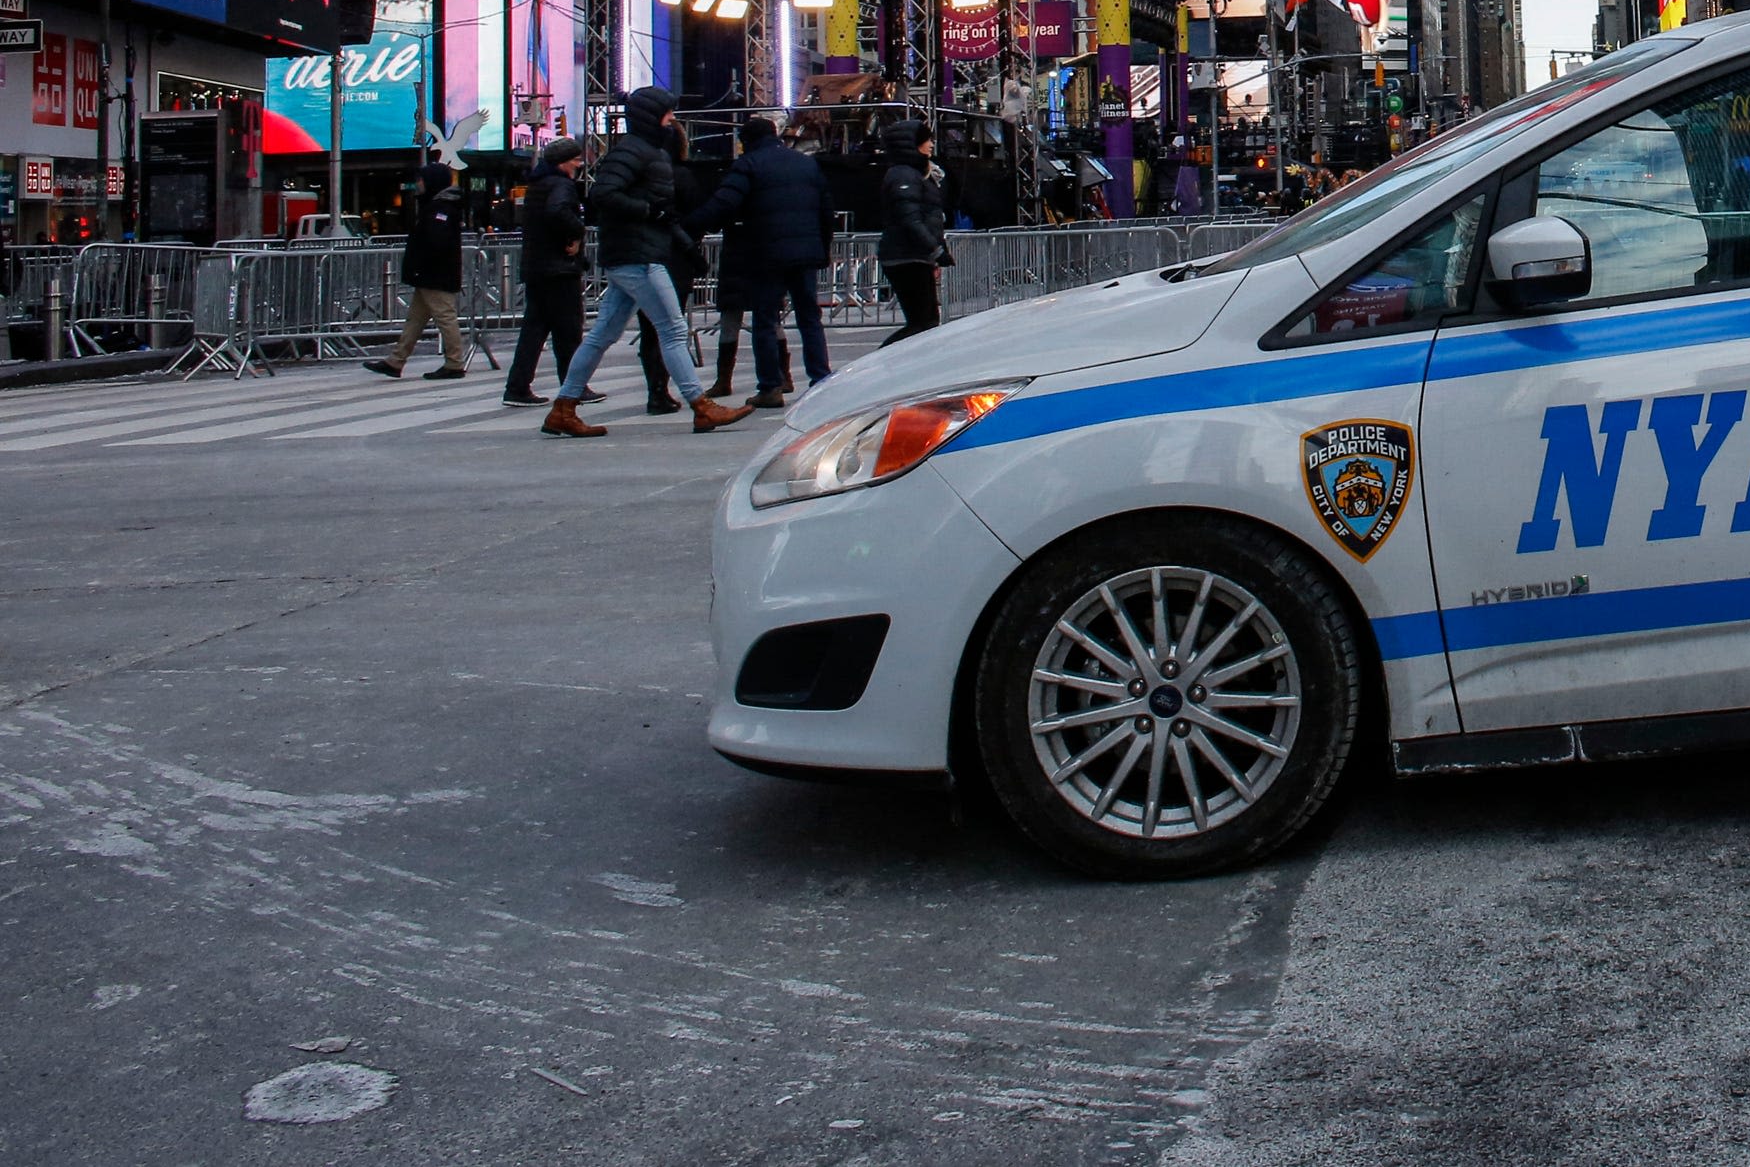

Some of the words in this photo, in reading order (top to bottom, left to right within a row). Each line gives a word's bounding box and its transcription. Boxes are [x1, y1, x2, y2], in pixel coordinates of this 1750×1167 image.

[971, 25, 987, 38] on
[76, 50, 99, 82] UNI
[1099, 102, 1125, 112] planet
[1328, 425, 1388, 445] POLICE
[1308, 438, 1407, 470] DEPARTMENT
[1312, 483, 1335, 517] CITY
[1331, 520, 1350, 538] OF
[1370, 511, 1394, 542] NEW
[1389, 469, 1408, 506] YORK
[1471, 579, 1568, 608] HYBRID
